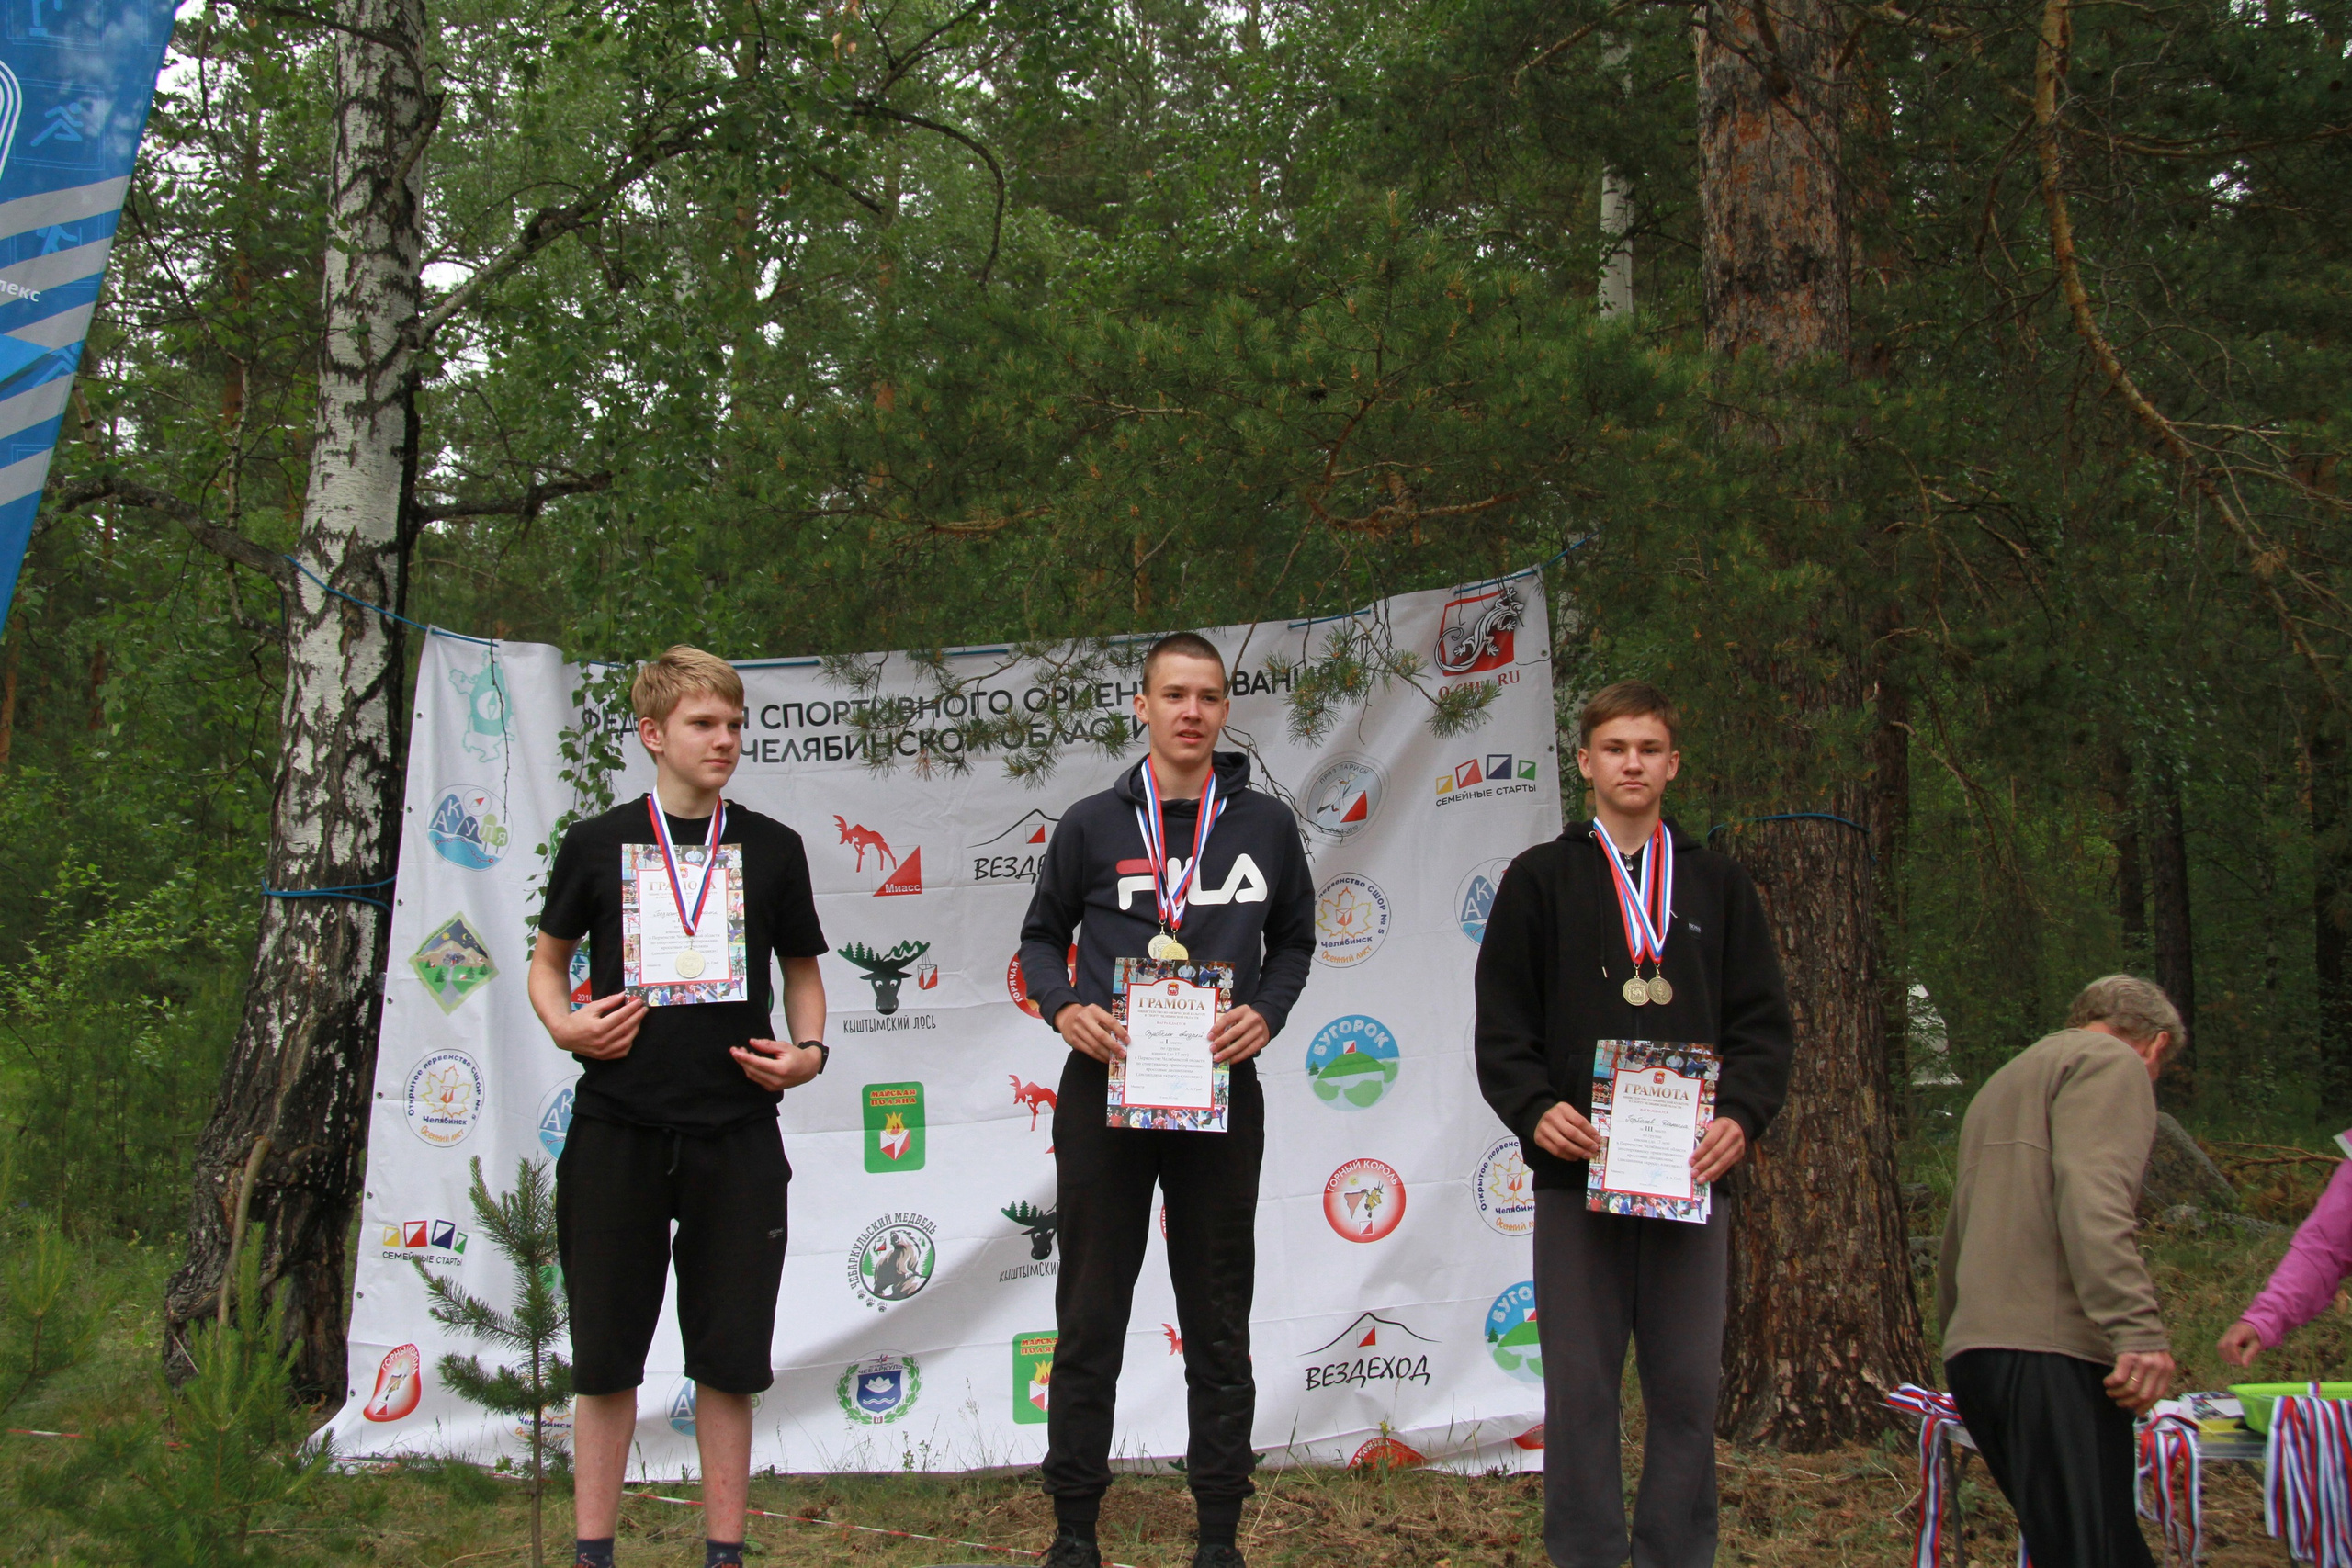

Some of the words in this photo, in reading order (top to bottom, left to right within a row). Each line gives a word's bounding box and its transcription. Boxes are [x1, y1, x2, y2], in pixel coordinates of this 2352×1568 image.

[0, 279, 41, 302] лекс
[741, 724, 991, 763] ЧЕЛЯБИНСКО
[1319, 768, 1337, 784] ПРИЗ
[1340, 763, 1370, 775] ЛАРИСЫ
[1436, 789, 1493, 807] СЕМЕЙНЫЕ
[1496, 784, 1536, 796] СТАРТЫ
[649, 880, 718, 892] ГРАОА
[885, 883, 921, 894] Миасс
[1115, 853, 1268, 910] FILA
[1318, 877, 1365, 898] первенство
[1367, 886, 1386, 910] СШОР
[1321, 936, 1373, 948] Челябинск
[1321, 950, 1354, 964] Осенний
[1356, 944, 1372, 959] лист
[1009, 961, 1023, 1003] ГОРЯЧАЯ
[1138, 997, 1205, 1010] ГРАМОТА
[843, 1014, 910, 1033] КЫШТЫМСКИЙ
[913, 1015, 937, 1030] ЛОСЬ
[1313, 1019, 1389, 1056] БУГОРОК
[408, 1069, 424, 1117] Открытое
[424, 1054, 471, 1070] первенство
[471, 1066, 481, 1095] СШОР
[870, 1089, 916, 1098] МАЙСКАЯ
[1623, 1083, 1689, 1100] ГРАМОТА
[870, 1097, 916, 1106] ПОЛЯНА
[423, 1115, 467, 1125] Челябинск
[1327, 1159, 1361, 1192] ГОРНЫЙ
[1363, 1160, 1398, 1185] КОРОЛЬ
[1477, 1161, 1488, 1211] Открытое
[1487, 1141, 1520, 1161] первенс
[1495, 1204, 1534, 1214] Челябин
[1496, 1216, 1527, 1231] Осенний
[382, 1250, 435, 1264] СЕМЕЙЫЕ
[435, 1256, 463, 1267] СТАРТЫ
[847, 1212, 892, 1290] ЧЕБАРКУЛЬСКИЙ
[894, 1212, 937, 1235] МЕДВЕДЬ
[1491, 1286, 1532, 1323] БУГО
[1021, 1337, 1058, 1347] МАЙСКА
[1021, 1346, 1056, 1355] ПОЛЯ
[858, 1364, 903, 1374] ЧЕБАРКУЛЬ
[1305, 1354, 1430, 1391] ВЕЗДЕХОД
[517, 1416, 572, 1429] Челбинск
